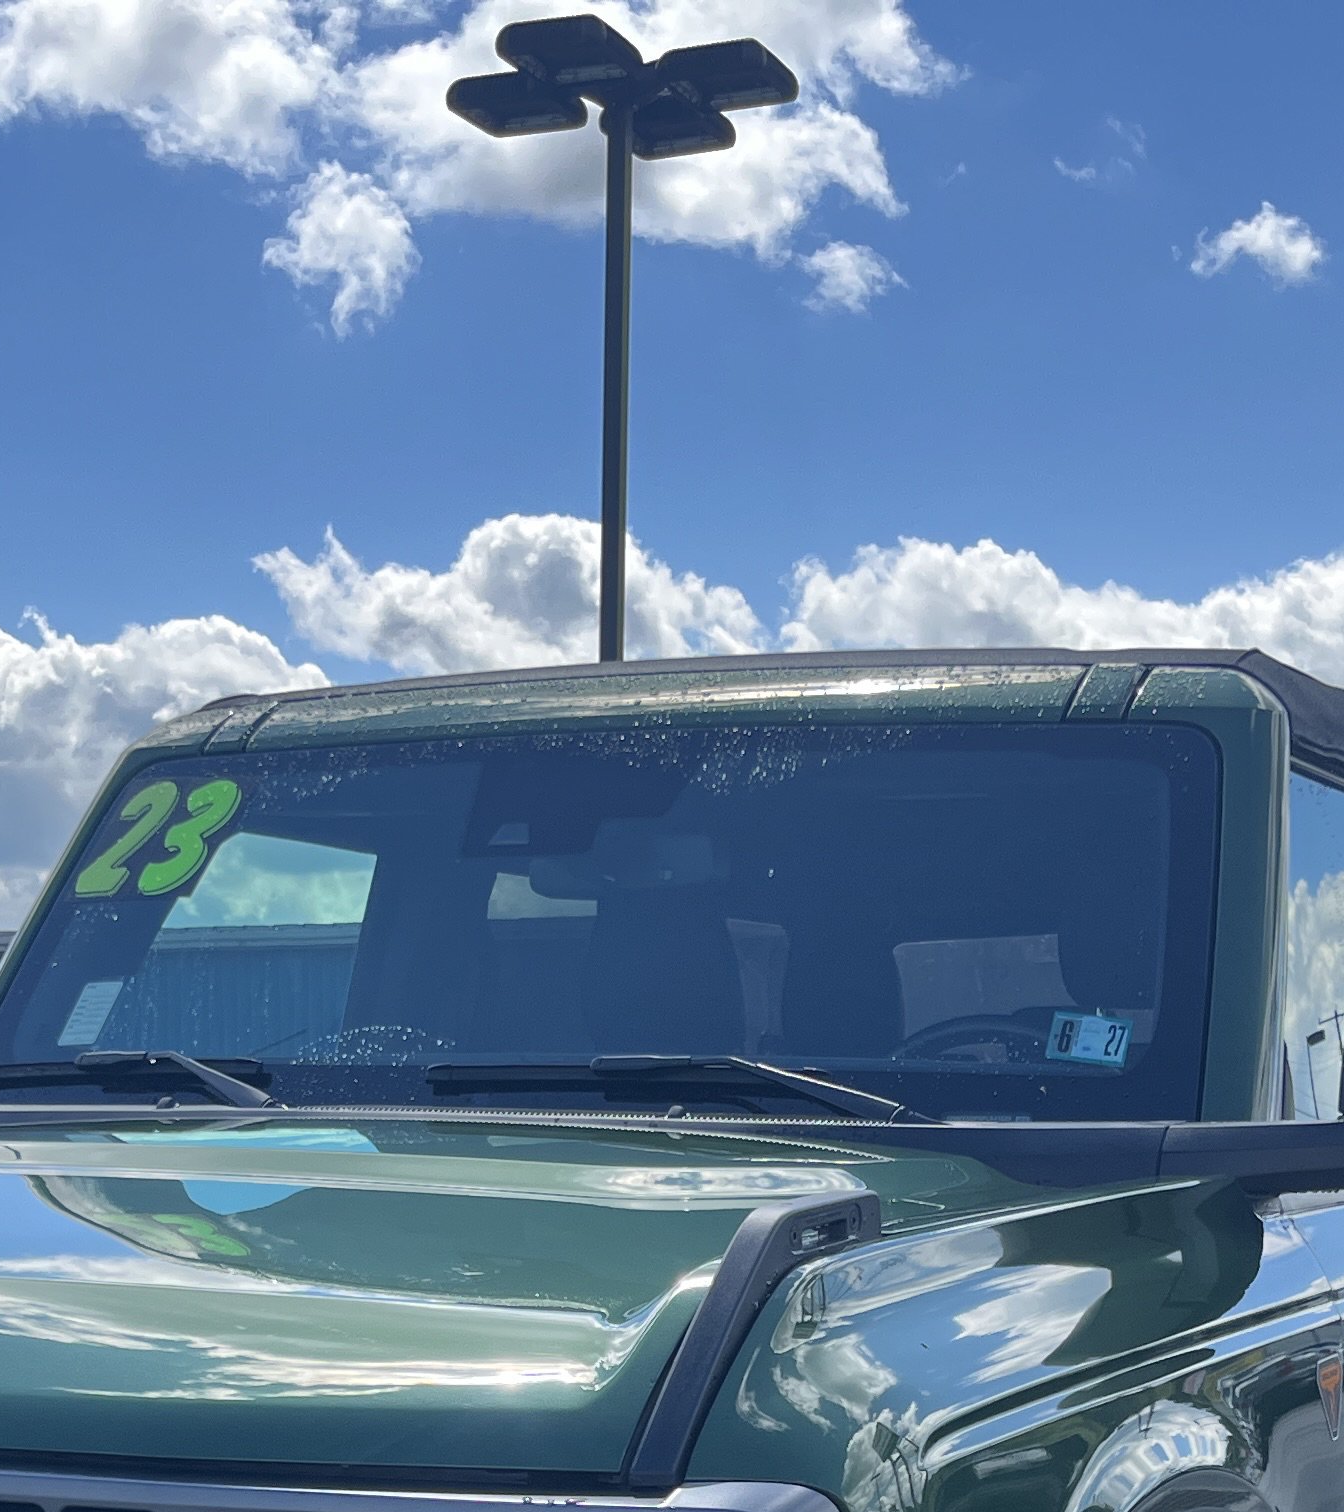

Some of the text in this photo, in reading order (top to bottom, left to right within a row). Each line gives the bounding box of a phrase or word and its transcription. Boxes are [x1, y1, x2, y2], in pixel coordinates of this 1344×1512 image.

[74, 780, 242, 898] 23
[1057, 1020, 1075, 1053] 6
[1103, 1024, 1127, 1057] 27
